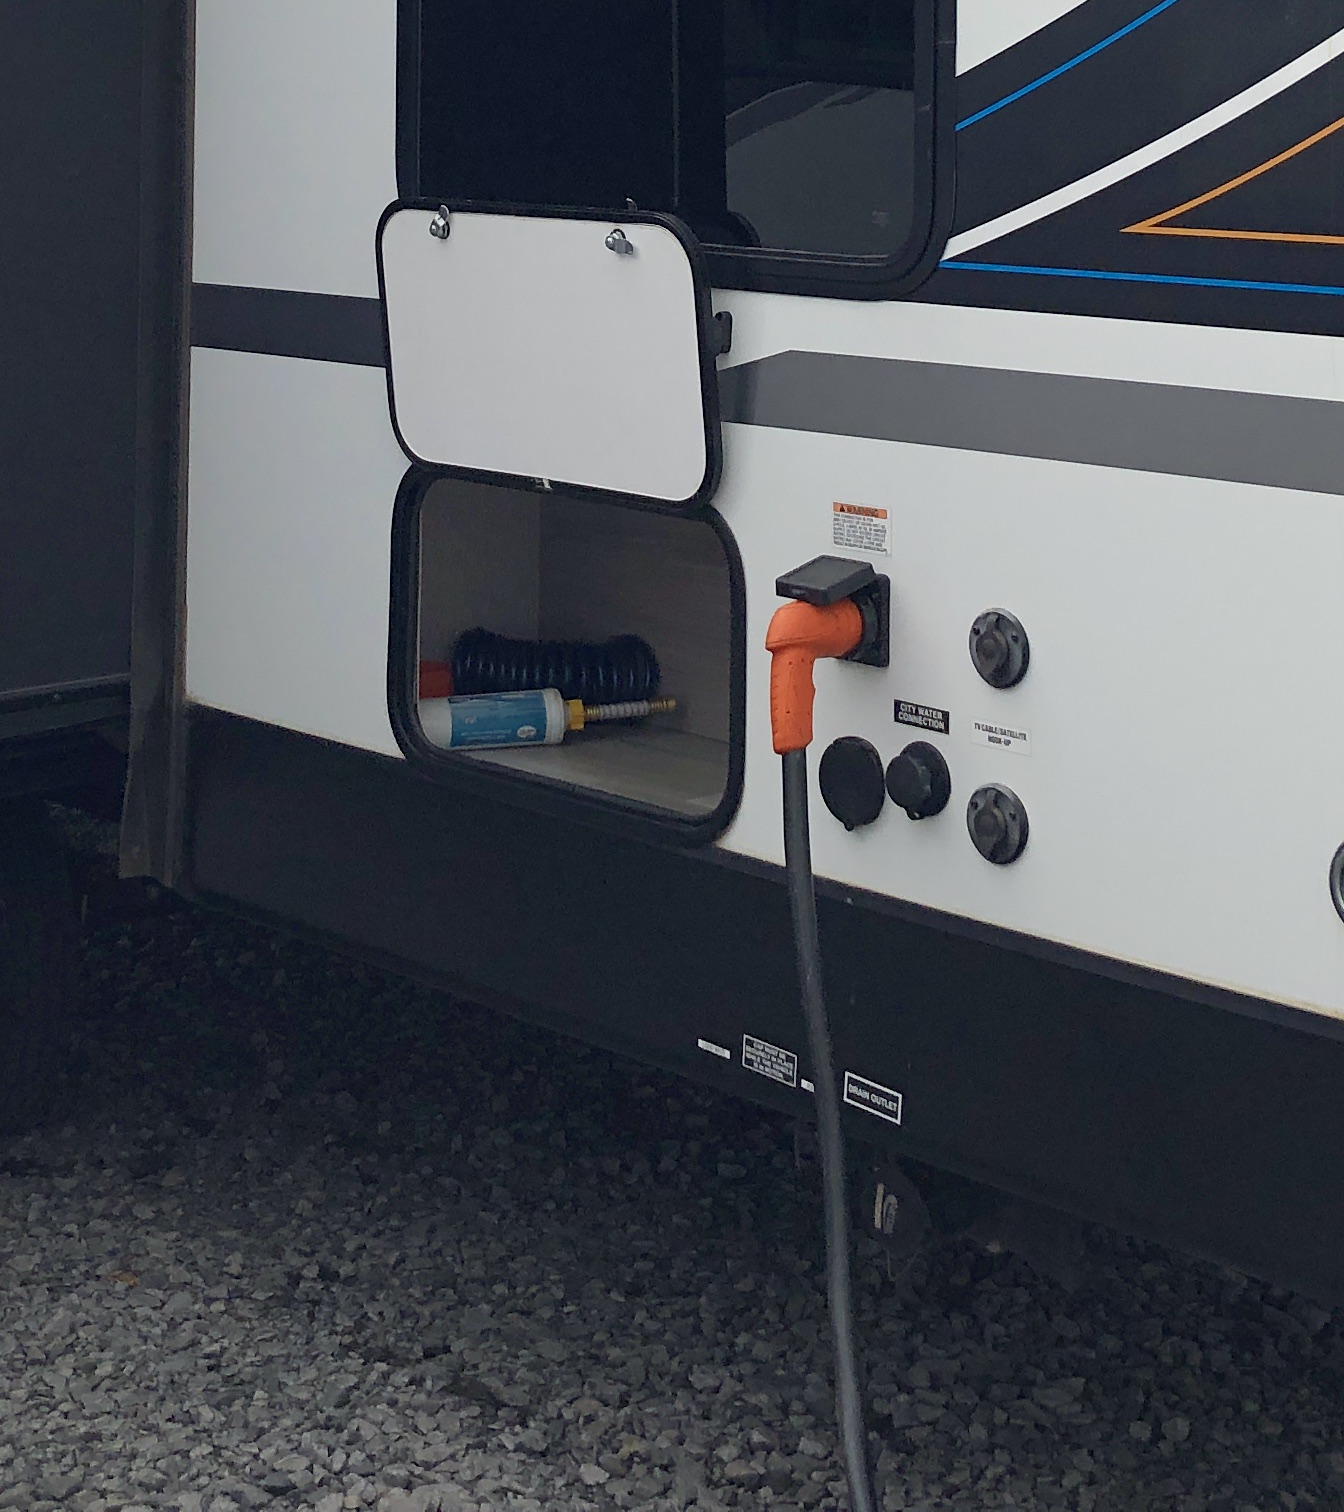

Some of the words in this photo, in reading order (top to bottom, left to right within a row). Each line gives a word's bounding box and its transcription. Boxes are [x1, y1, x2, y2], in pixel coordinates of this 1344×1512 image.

[899, 703, 916, 714] CITY
[917, 706, 943, 719] WATER
[898, 712, 945, 730] CONNECTION
[870, 1093, 897, 1112] OUTLET
